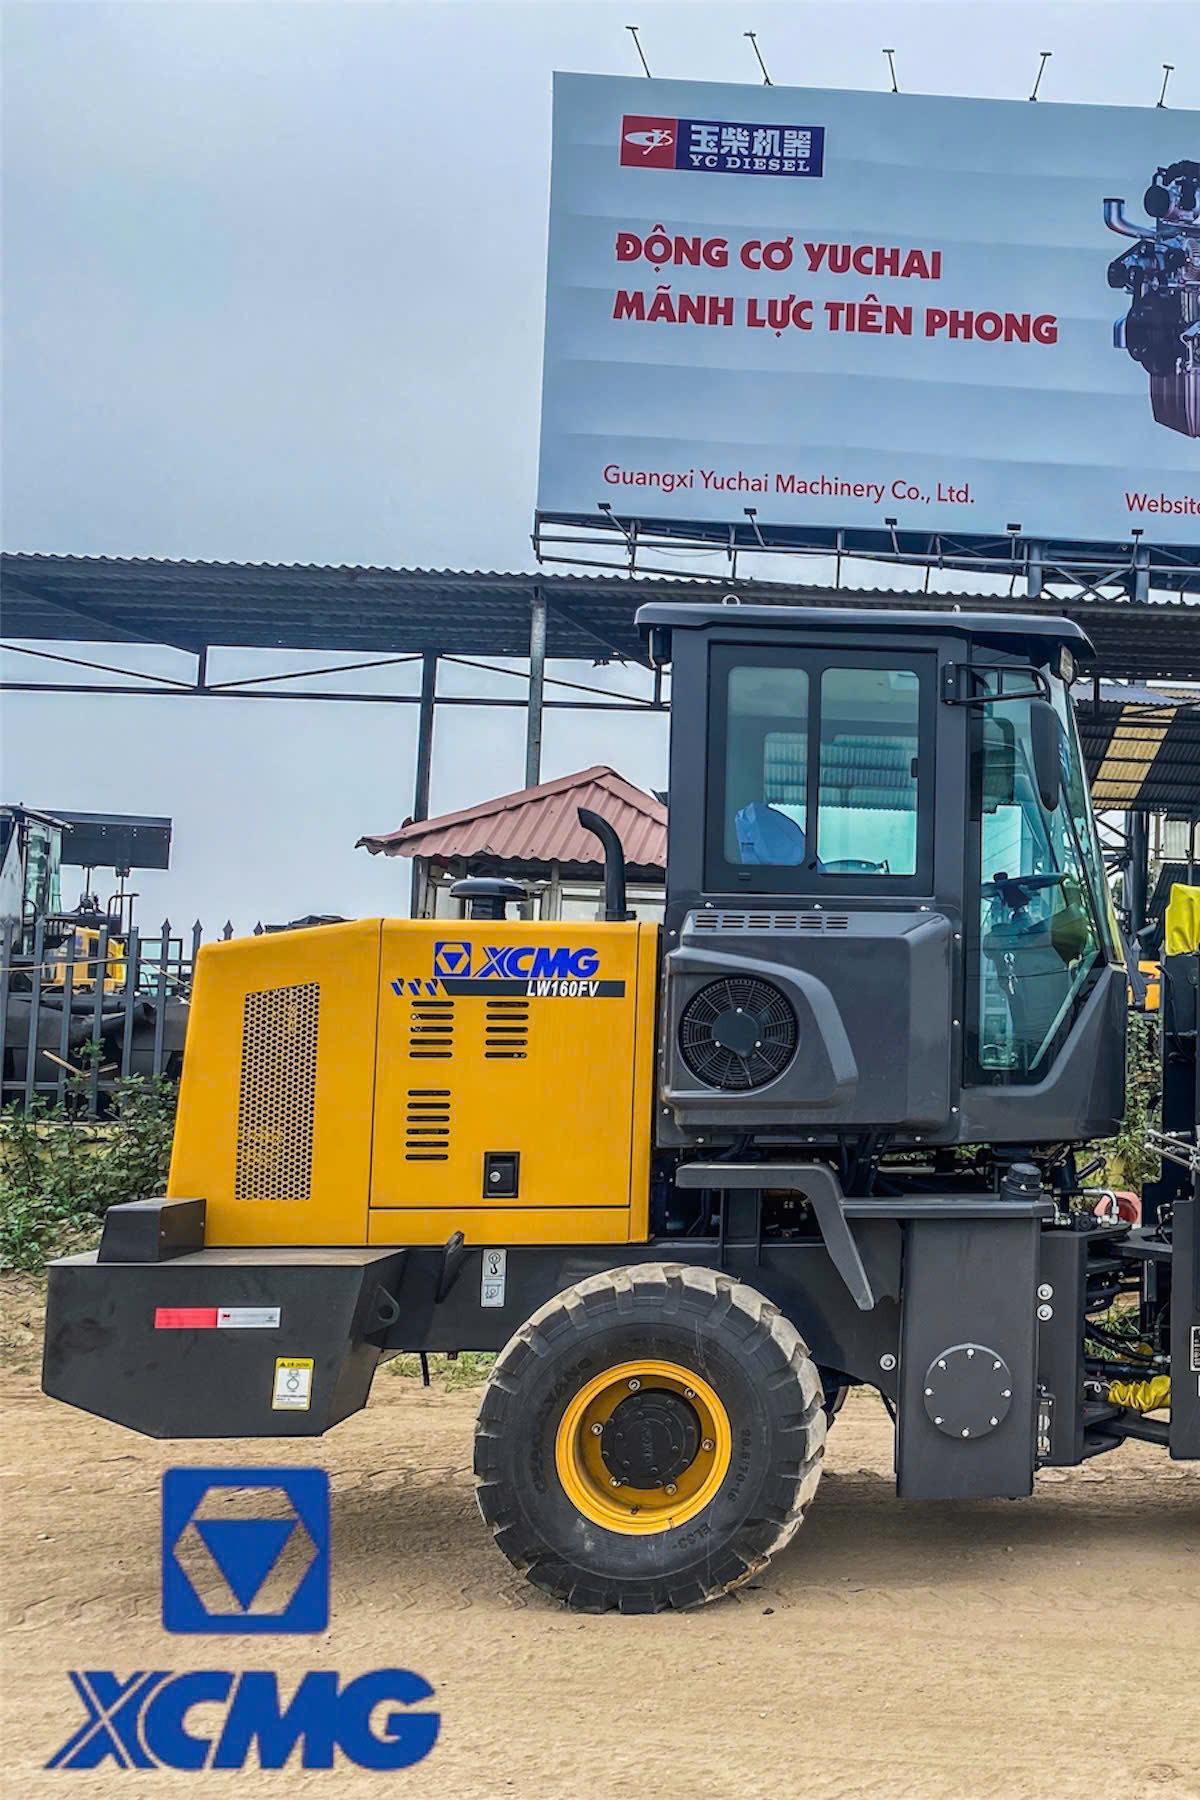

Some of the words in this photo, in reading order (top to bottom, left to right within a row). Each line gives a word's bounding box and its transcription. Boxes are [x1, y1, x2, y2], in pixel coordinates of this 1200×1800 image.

[689, 124, 812, 159] 玉柴机器
[689, 153, 718, 169] YC
[726, 156, 810, 173] DIESEL
[615, 224, 729, 273] ĐỘNG
[740, 236, 794, 271] CƠ
[804, 242, 942, 280] YUCHAI
[613, 284, 734, 326] MÃNH
[746, 294, 814, 338] LỰC
[824, 294, 913, 337] TIÊN
[924, 308, 1058, 345] PHONG
[602, 464, 694, 493] Guangxi
[700, 469, 769, 494] Yuchai
[775, 473, 886, 504] Machinery
[891, 481, 931, 505] Co.,
[936, 483, 976, 504] Ltd.
[472, 947, 601, 978] XCMG
[526, 980, 601, 998] LW160FV
